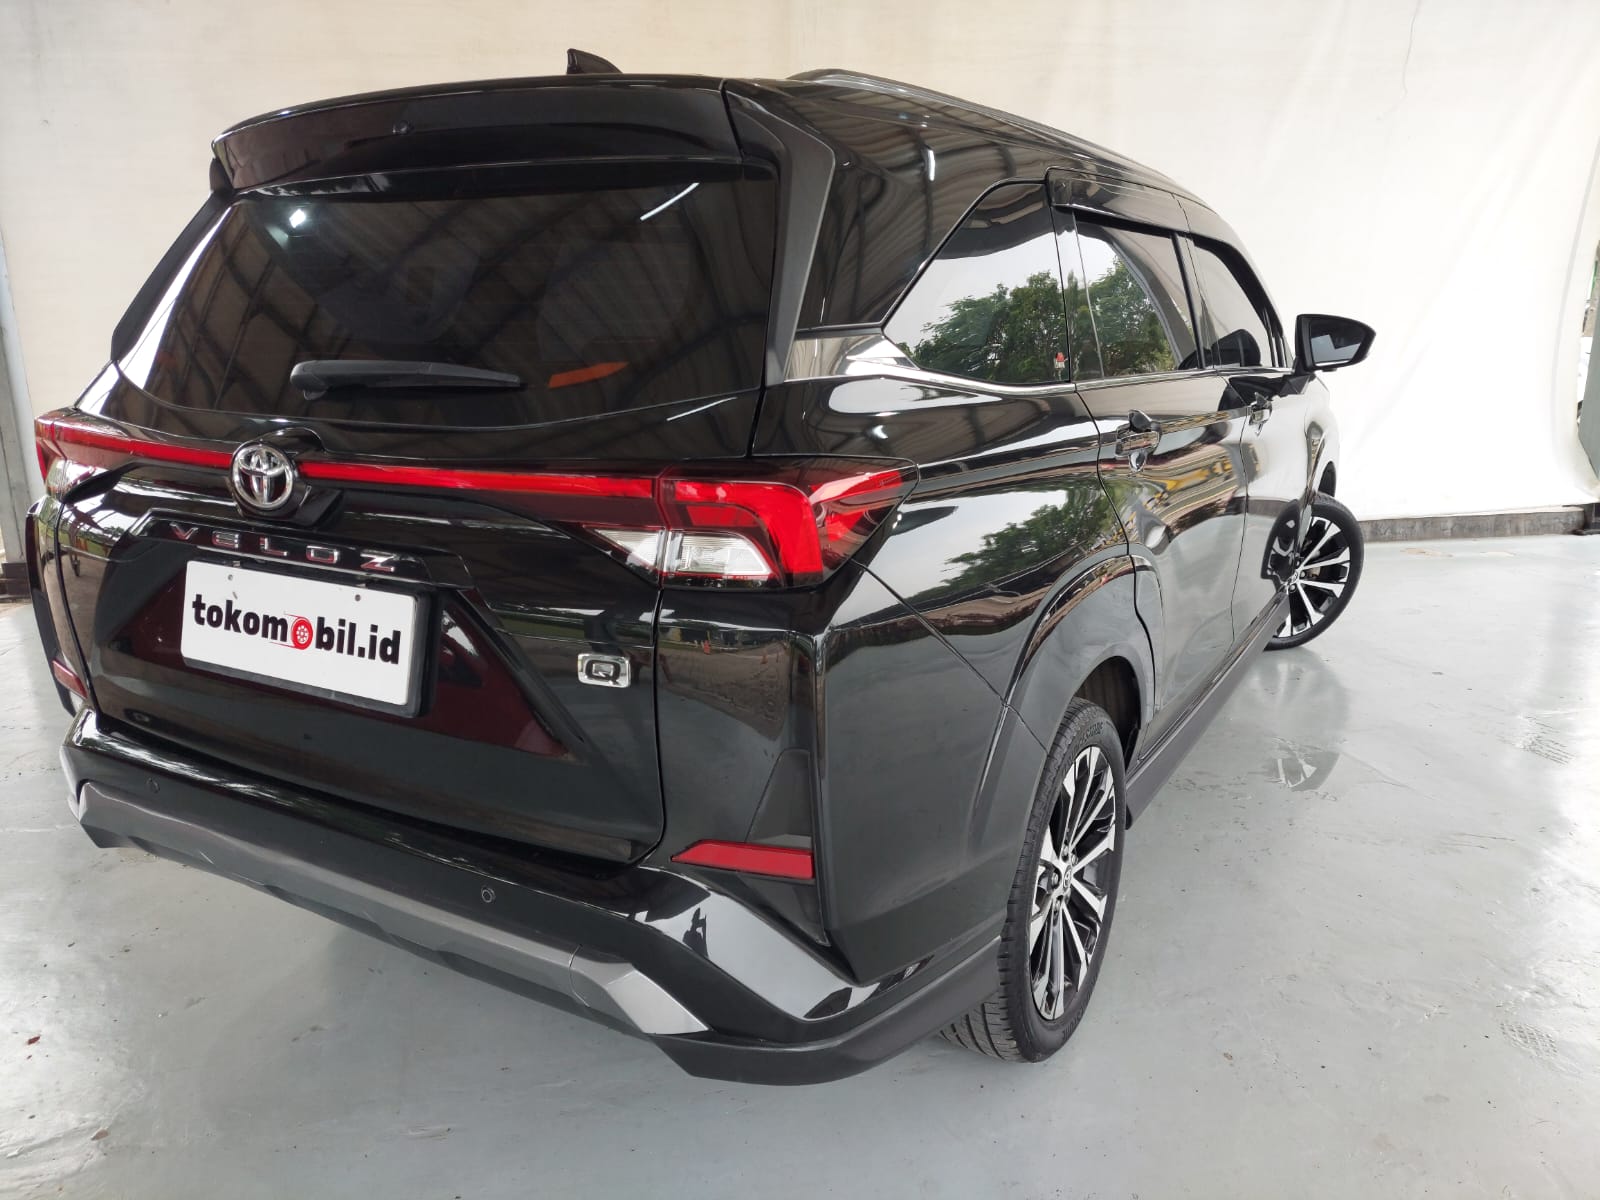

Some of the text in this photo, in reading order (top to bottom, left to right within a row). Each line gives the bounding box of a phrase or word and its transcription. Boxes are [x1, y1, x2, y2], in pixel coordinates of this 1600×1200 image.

[169, 522, 396, 572] VELOZ
[192, 594, 401, 665] tokomobil.id
[583, 657, 624, 685] Q
